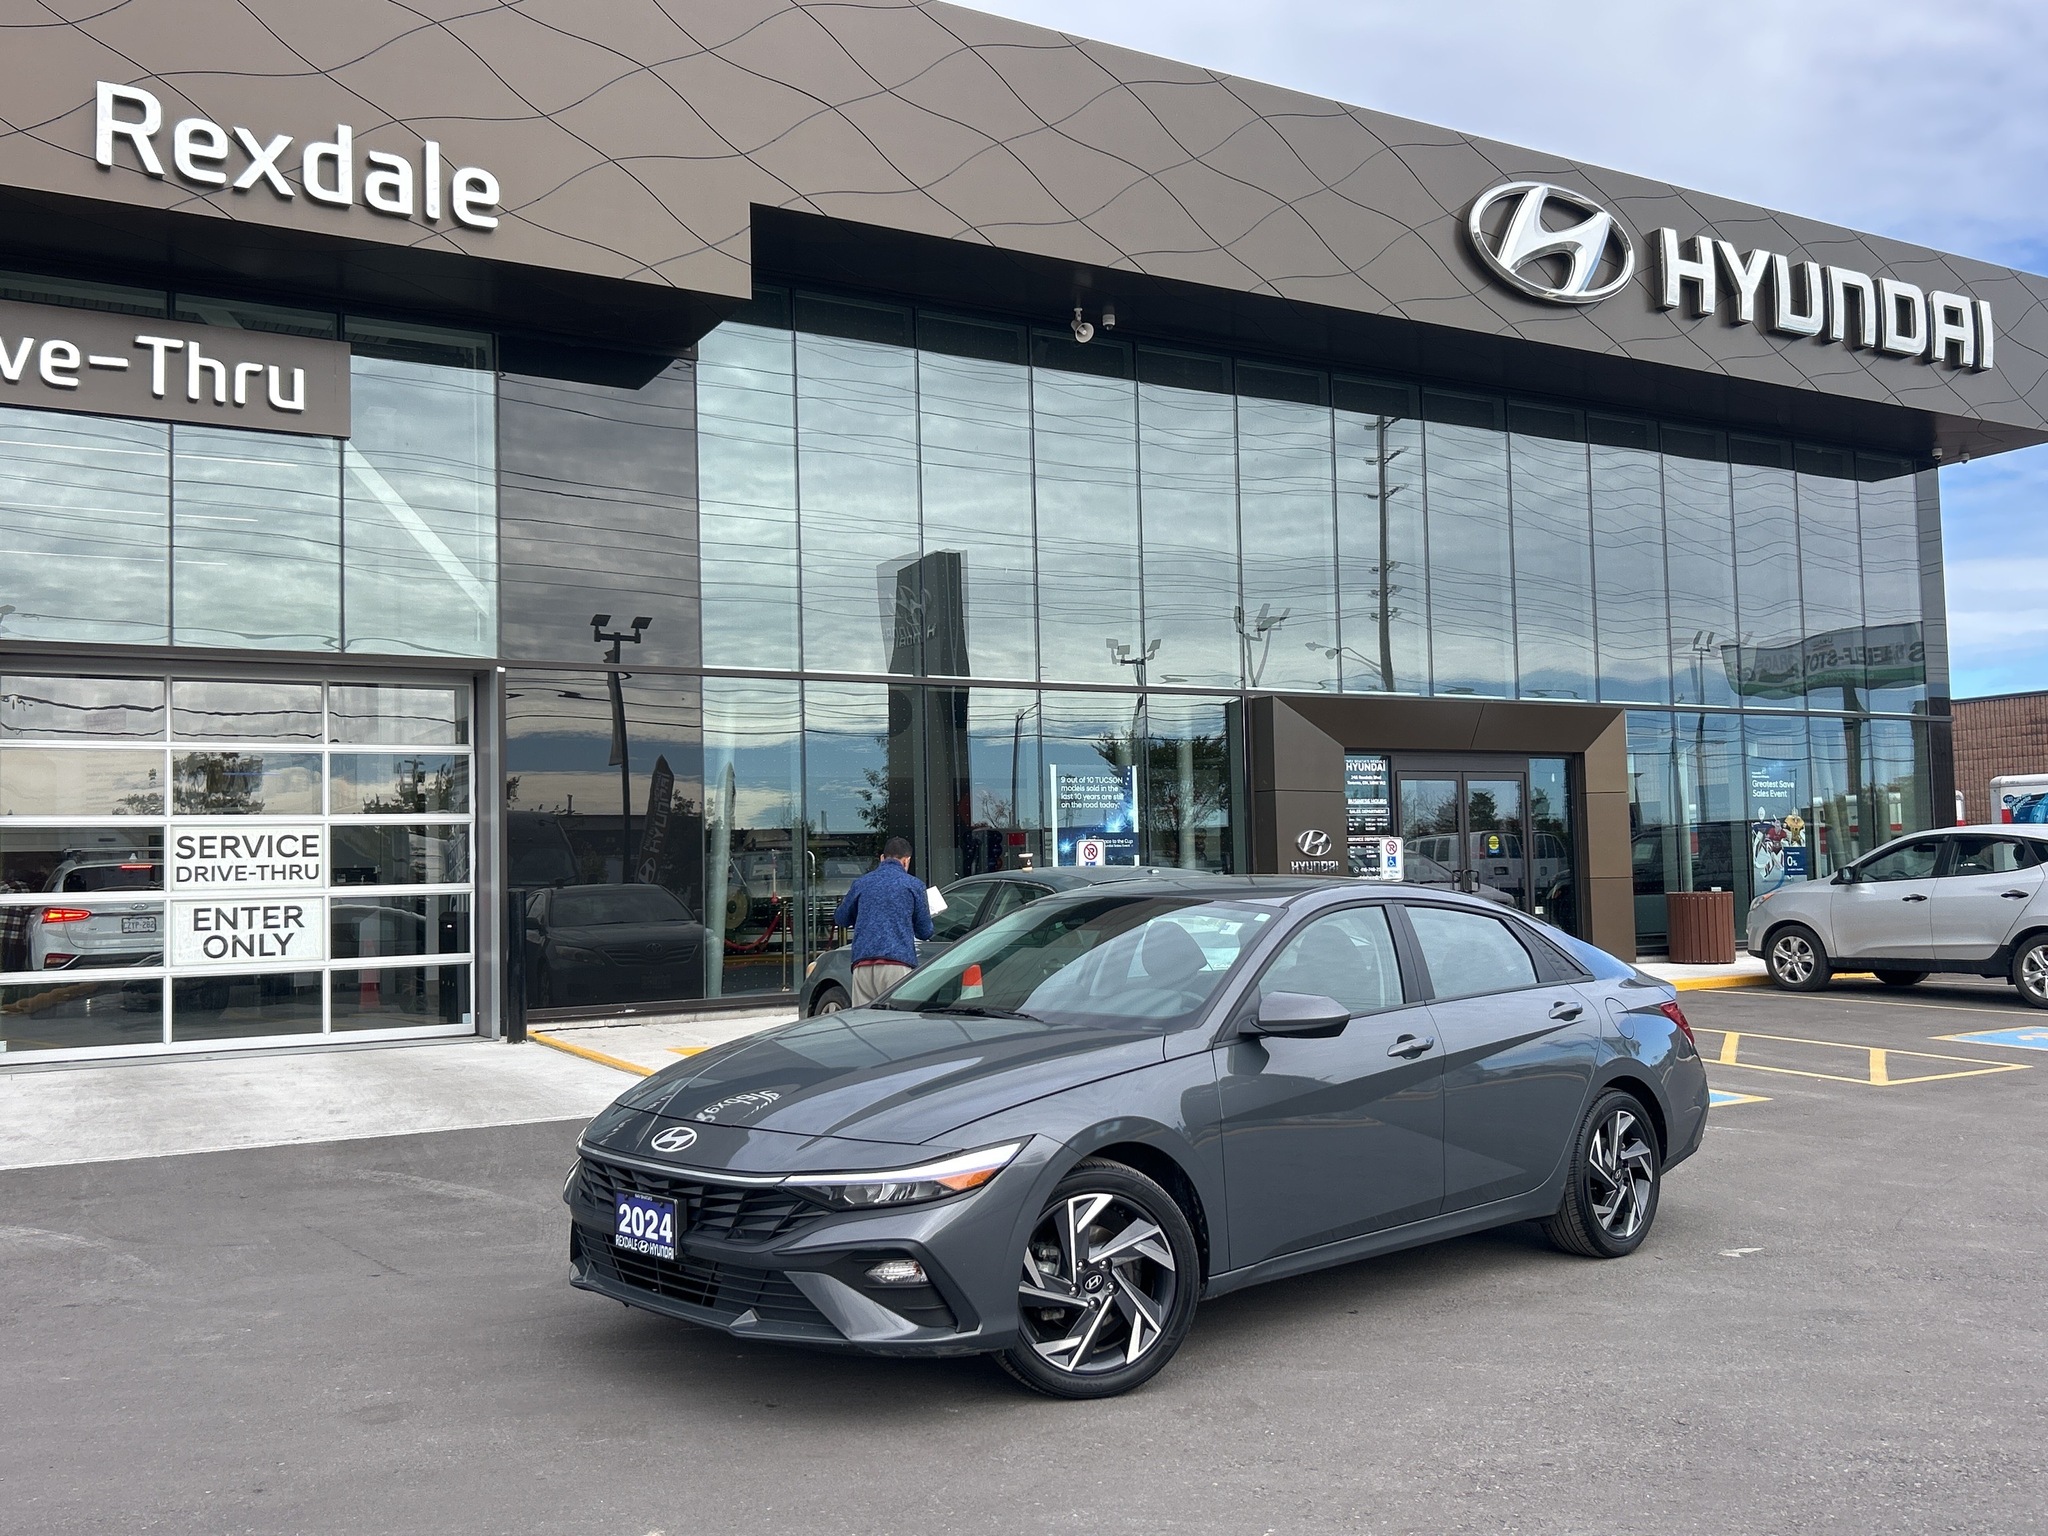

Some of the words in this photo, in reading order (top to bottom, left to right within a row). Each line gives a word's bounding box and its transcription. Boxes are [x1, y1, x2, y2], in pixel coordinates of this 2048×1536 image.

[95, 80, 501, 230] Rexdale
[1655, 227, 1994, 372] HYUNDAI
[1346, 762, 1386, 771] HYUNDAI
[1060, 776, 1066, 784] 9
[1079, 776, 1086, 784] of
[1087, 776, 1094, 784] 10
[1095, 776, 1123, 784] TUCSON
[1752, 780, 1779, 788] Greatest
[1779, 780, 1795, 789] Save
[1060, 792, 1074, 800] last
[1075, 792, 1082, 800] 10
[1083, 793, 1101, 801] years
[1113, 792, 1125, 800] still
[1770, 790, 1788, 798] Event
[1071, 801, 1082, 809] the
[1083, 801, 1099, 809] road
[175, 834, 320, 860] SERVICE
[176, 863, 320, 883] DRIVE-THRU
[1291, 860, 1339, 873] HYUNDAI
[193, 905, 305, 932] ENTER
[203, 932, 295, 959] ONLY
[618, 1203, 673, 1244] 2024
[615, 1233, 638, 1251] REXDALE
[649, 1242, 675, 1260] HYUNDAI
